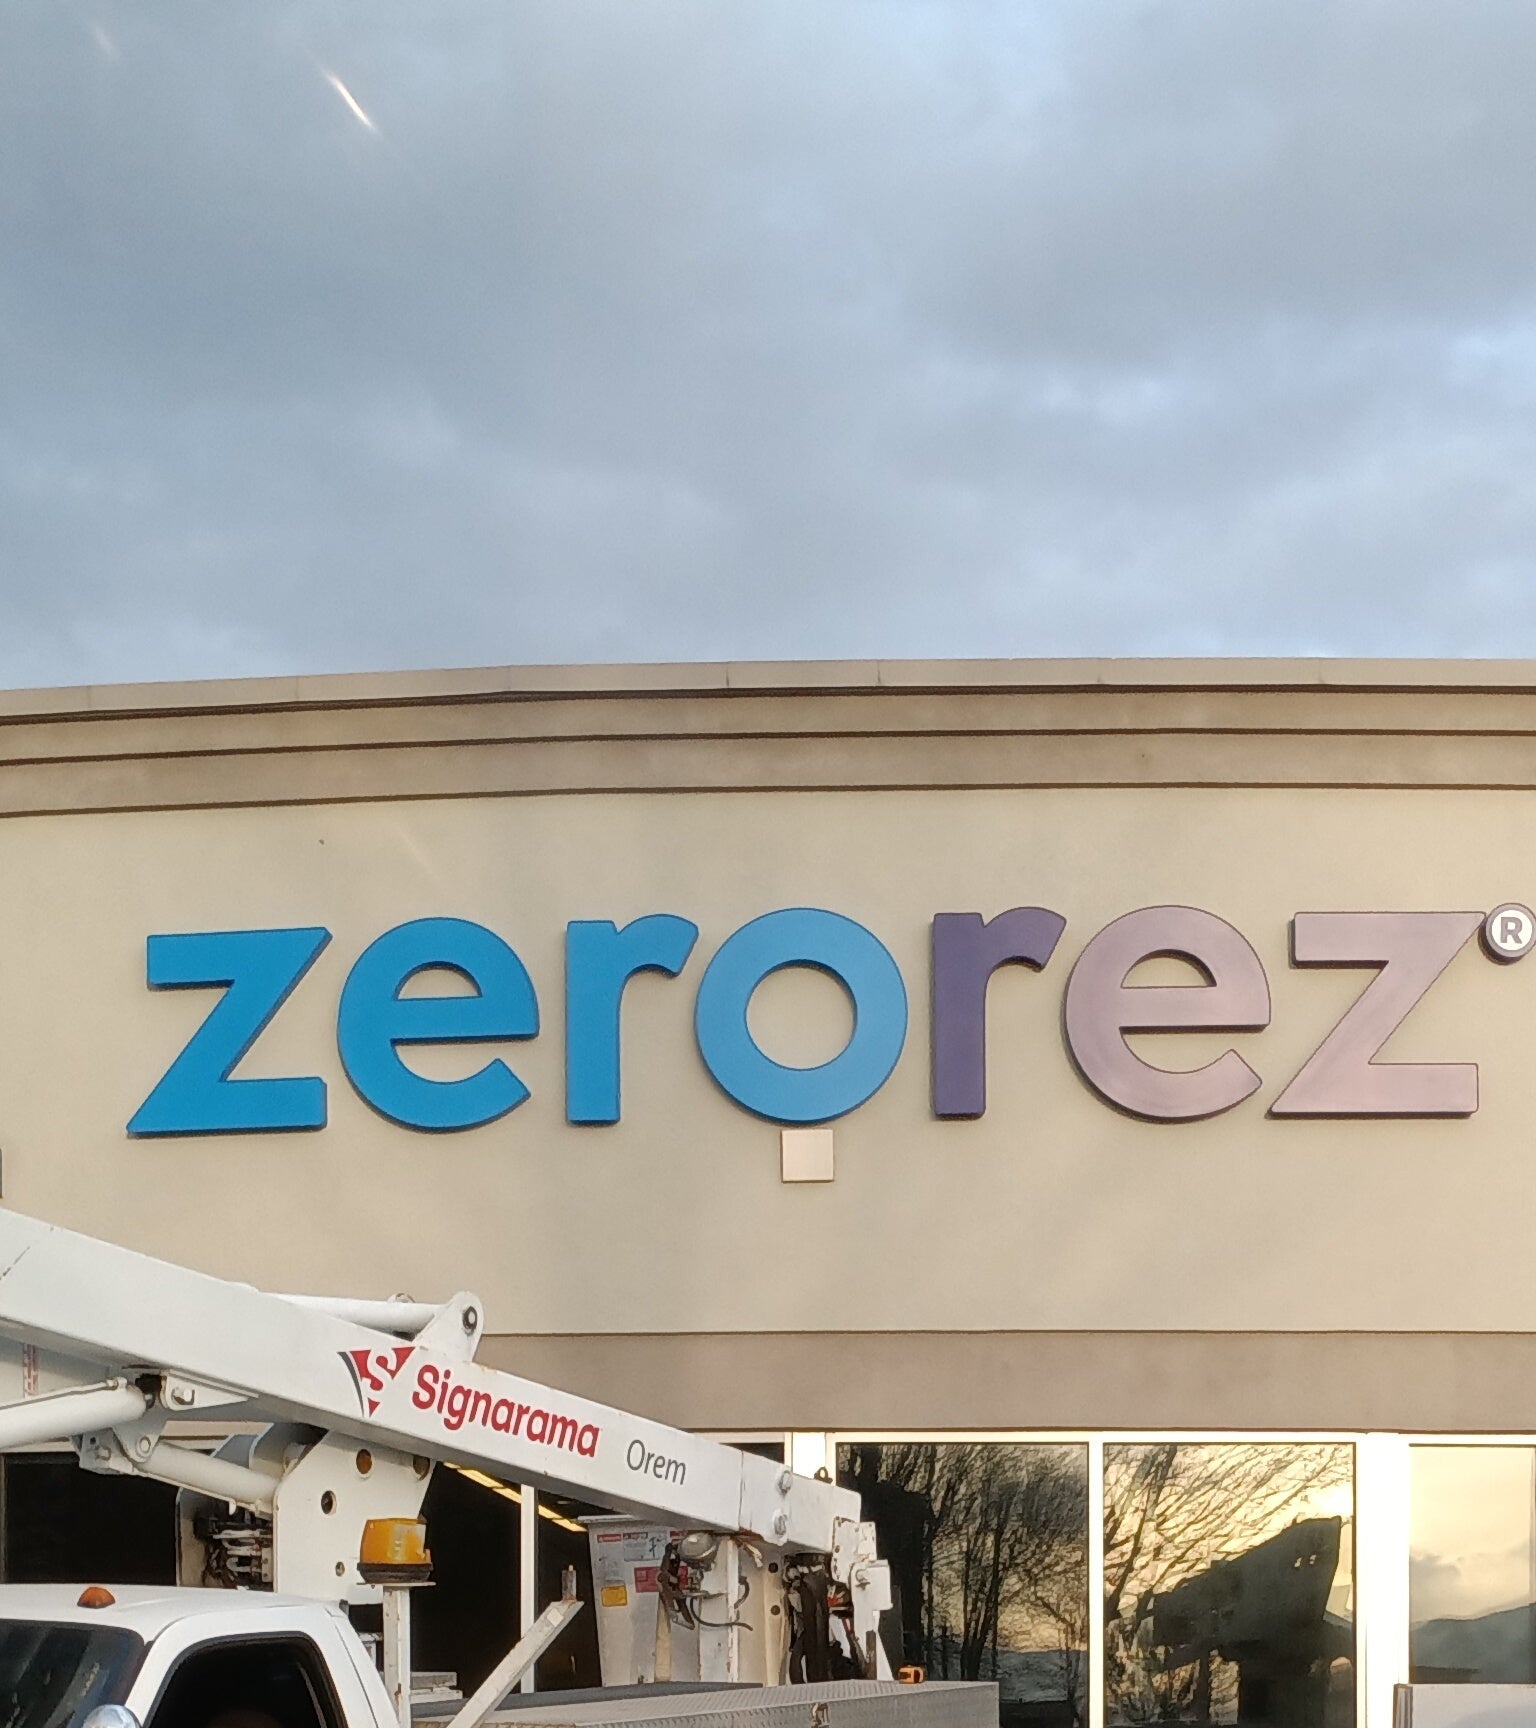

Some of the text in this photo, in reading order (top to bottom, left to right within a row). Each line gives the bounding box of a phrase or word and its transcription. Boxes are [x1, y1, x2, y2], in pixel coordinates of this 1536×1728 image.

[127, 905, 1487, 1137] zerorez
[412, 1364, 687, 1486] Signarama Orem
